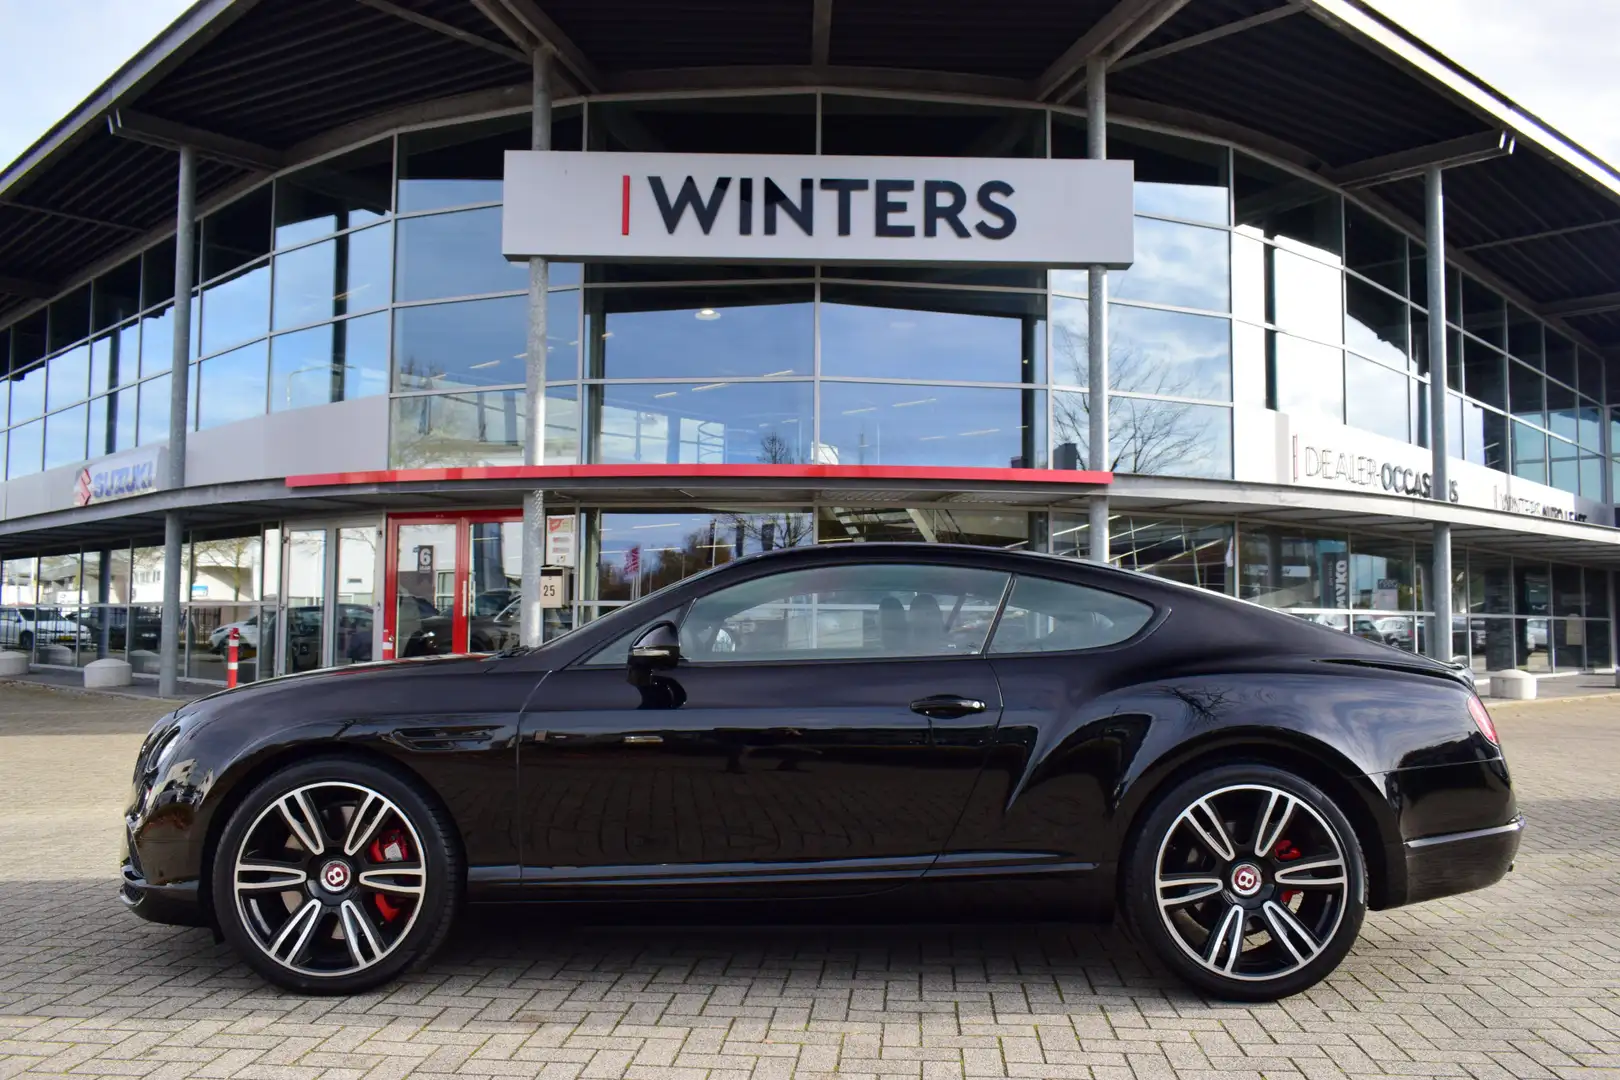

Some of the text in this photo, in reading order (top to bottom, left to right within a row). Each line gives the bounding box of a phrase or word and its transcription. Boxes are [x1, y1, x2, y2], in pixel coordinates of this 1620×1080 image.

[647, 176, 1017, 240] WINTERS
[93, 461, 153, 498] SUZUKI
[1305, 446, 1459, 503] DEALER-OCCASS
[543, 585, 555, 597] 25
